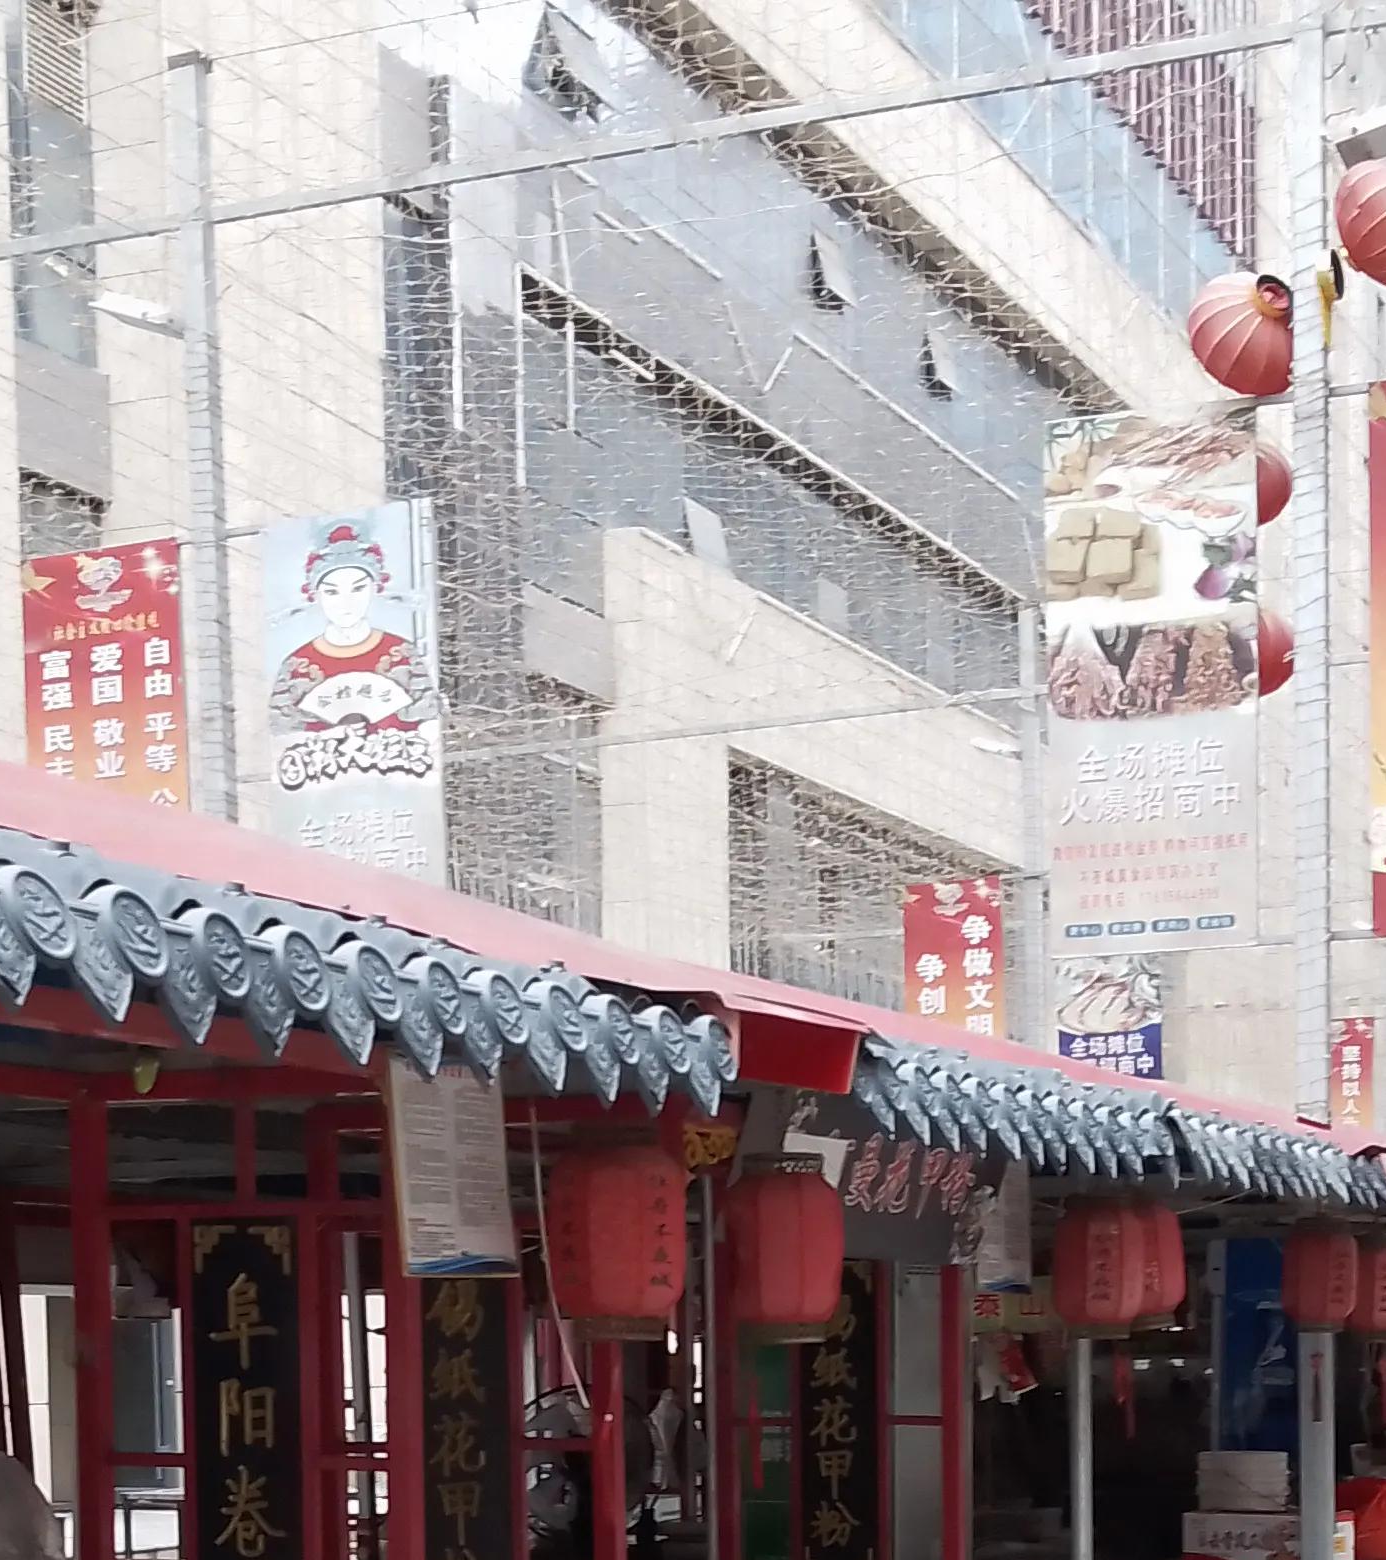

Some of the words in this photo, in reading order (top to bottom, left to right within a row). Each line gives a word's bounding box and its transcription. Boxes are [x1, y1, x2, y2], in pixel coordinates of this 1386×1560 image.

[39, 650, 75, 712] 富强
[89, 642, 125, 706] 爱国
[143, 637, 174, 699] 自由
[92, 718, 127, 781] 敬业
[143, 711, 178, 773] 平等
[1076, 736, 1226, 785] 全场摊位
[1059, 776, 1243, 827] 火爆招商中
[915, 953, 947, 1015] 争创
[960, 914, 995, 1036] 争做文明
[1069, 1033, 1146, 1061] 全场摊位
